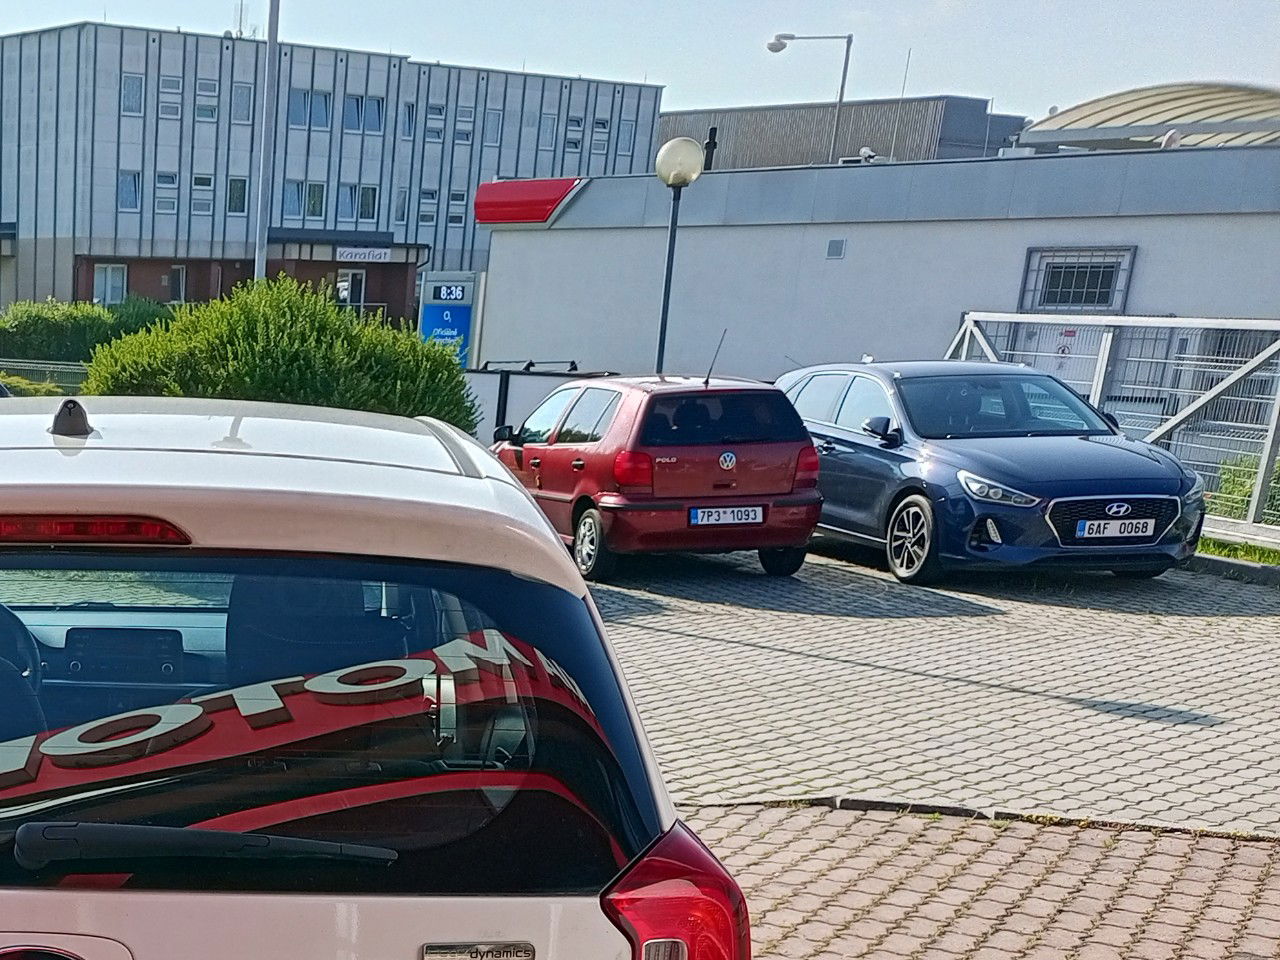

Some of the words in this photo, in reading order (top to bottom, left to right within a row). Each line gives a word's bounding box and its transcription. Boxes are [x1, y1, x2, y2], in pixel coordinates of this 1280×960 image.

[440, 285, 463, 300] 8:36
[655, 456, 677, 464] POLO
[700, 510, 721, 523] 7P3
[731, 509, 758, 521] 1093
[1086, 522, 1111, 536] 6AF
[1119, 521, 1149, 535] 0068
